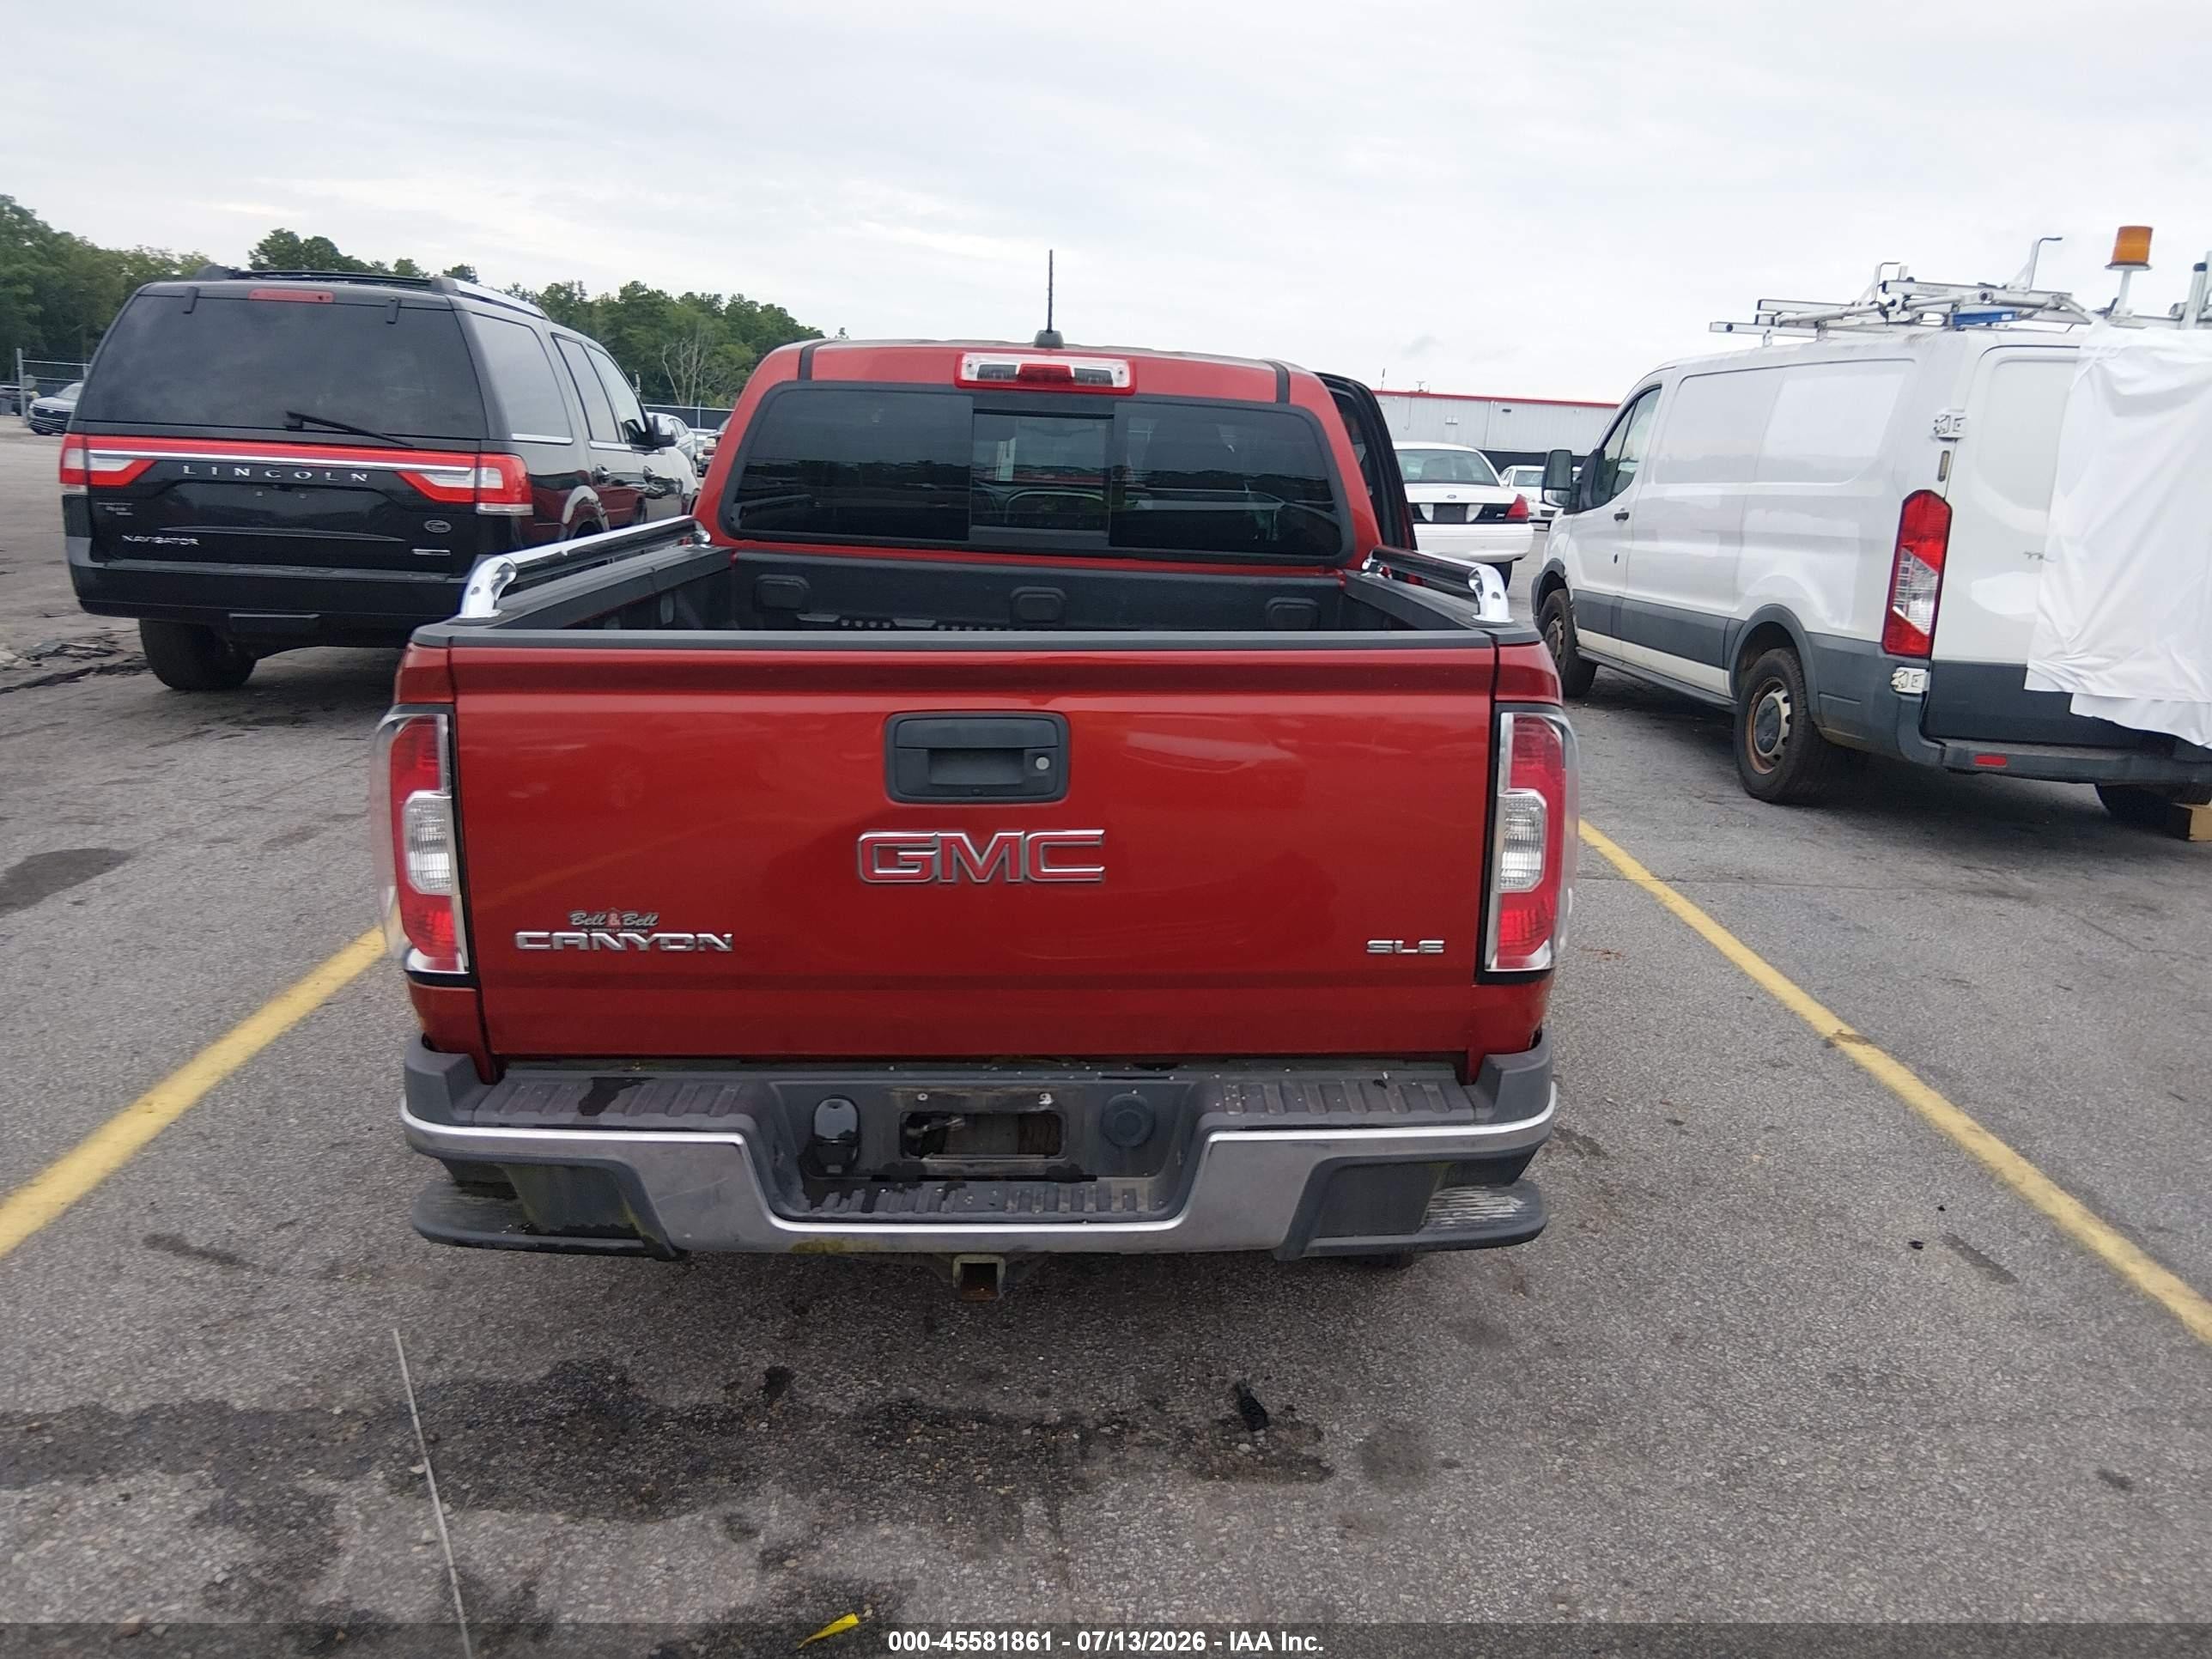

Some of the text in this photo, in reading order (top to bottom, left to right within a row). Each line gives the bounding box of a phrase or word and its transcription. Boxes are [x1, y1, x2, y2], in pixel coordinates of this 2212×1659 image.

[183, 465, 368, 483] LINCOLN
[121, 534, 199, 546] NAVIGATOR
[858, 828, 1105, 884] GMC
[569, 911, 659, 927] Bell & Bell
[514, 931, 733, 951] CANYON
[1366, 939, 1445, 954] SLE
